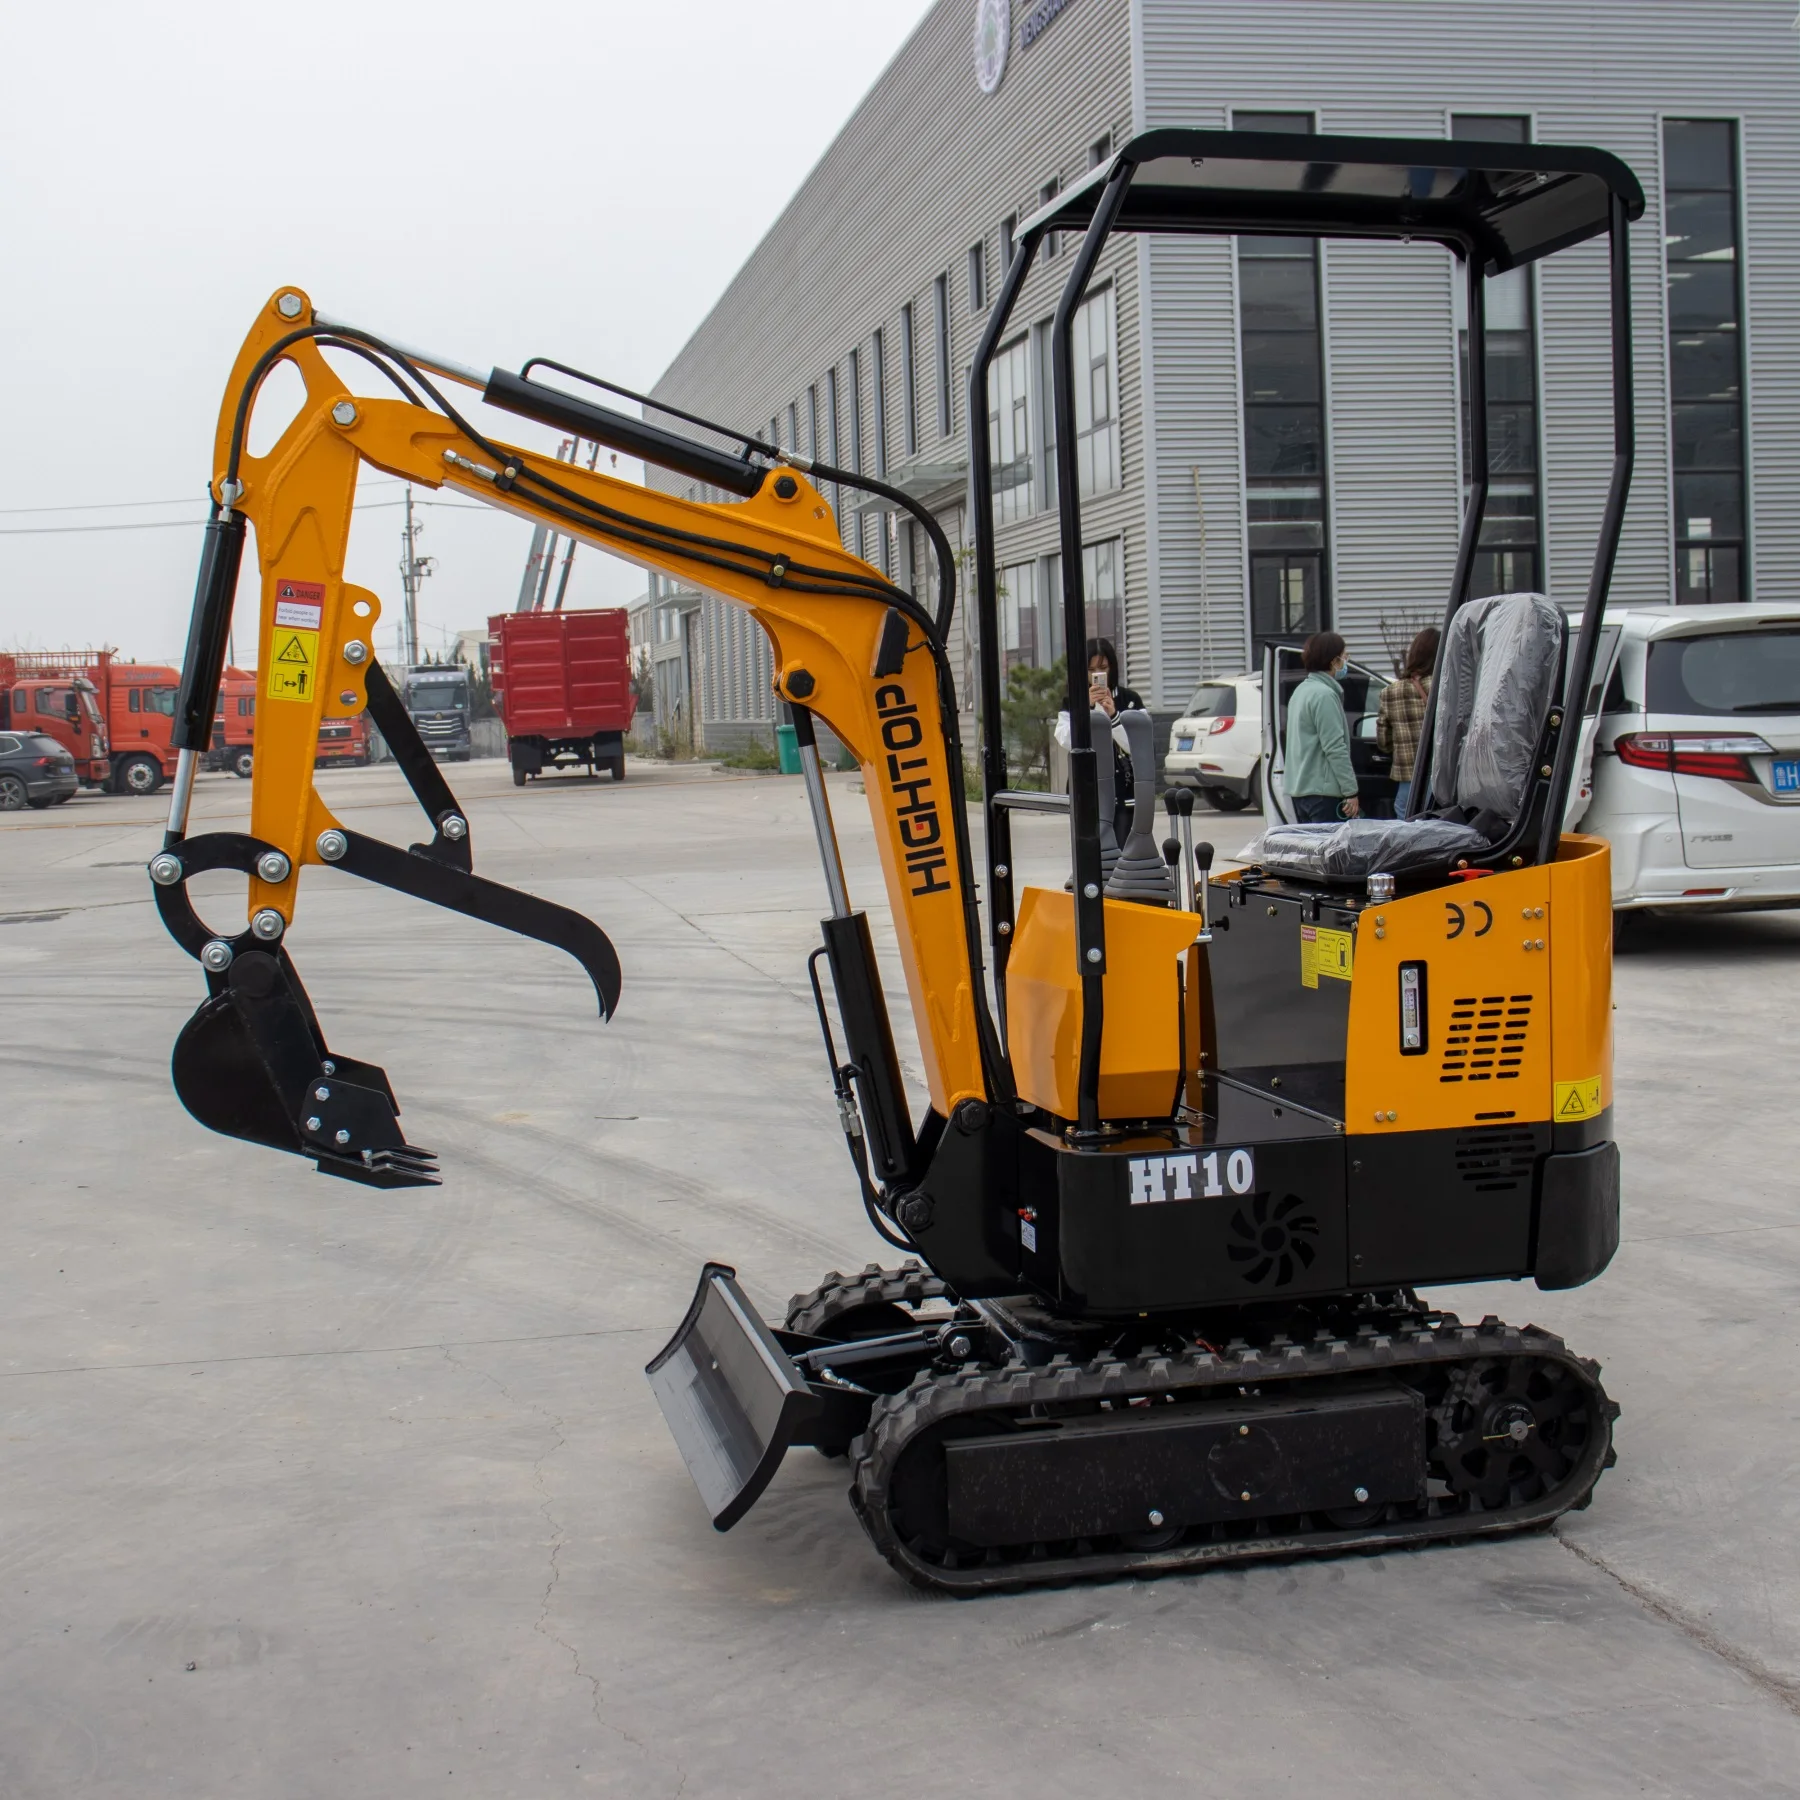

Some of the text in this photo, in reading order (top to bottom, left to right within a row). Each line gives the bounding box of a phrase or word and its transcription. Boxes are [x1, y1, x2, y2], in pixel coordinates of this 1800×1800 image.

[296, 589, 320, 599] DANGER
[875, 684, 951, 897] HIGHTOP
[1129, 1149, 1253, 1205] HT10
